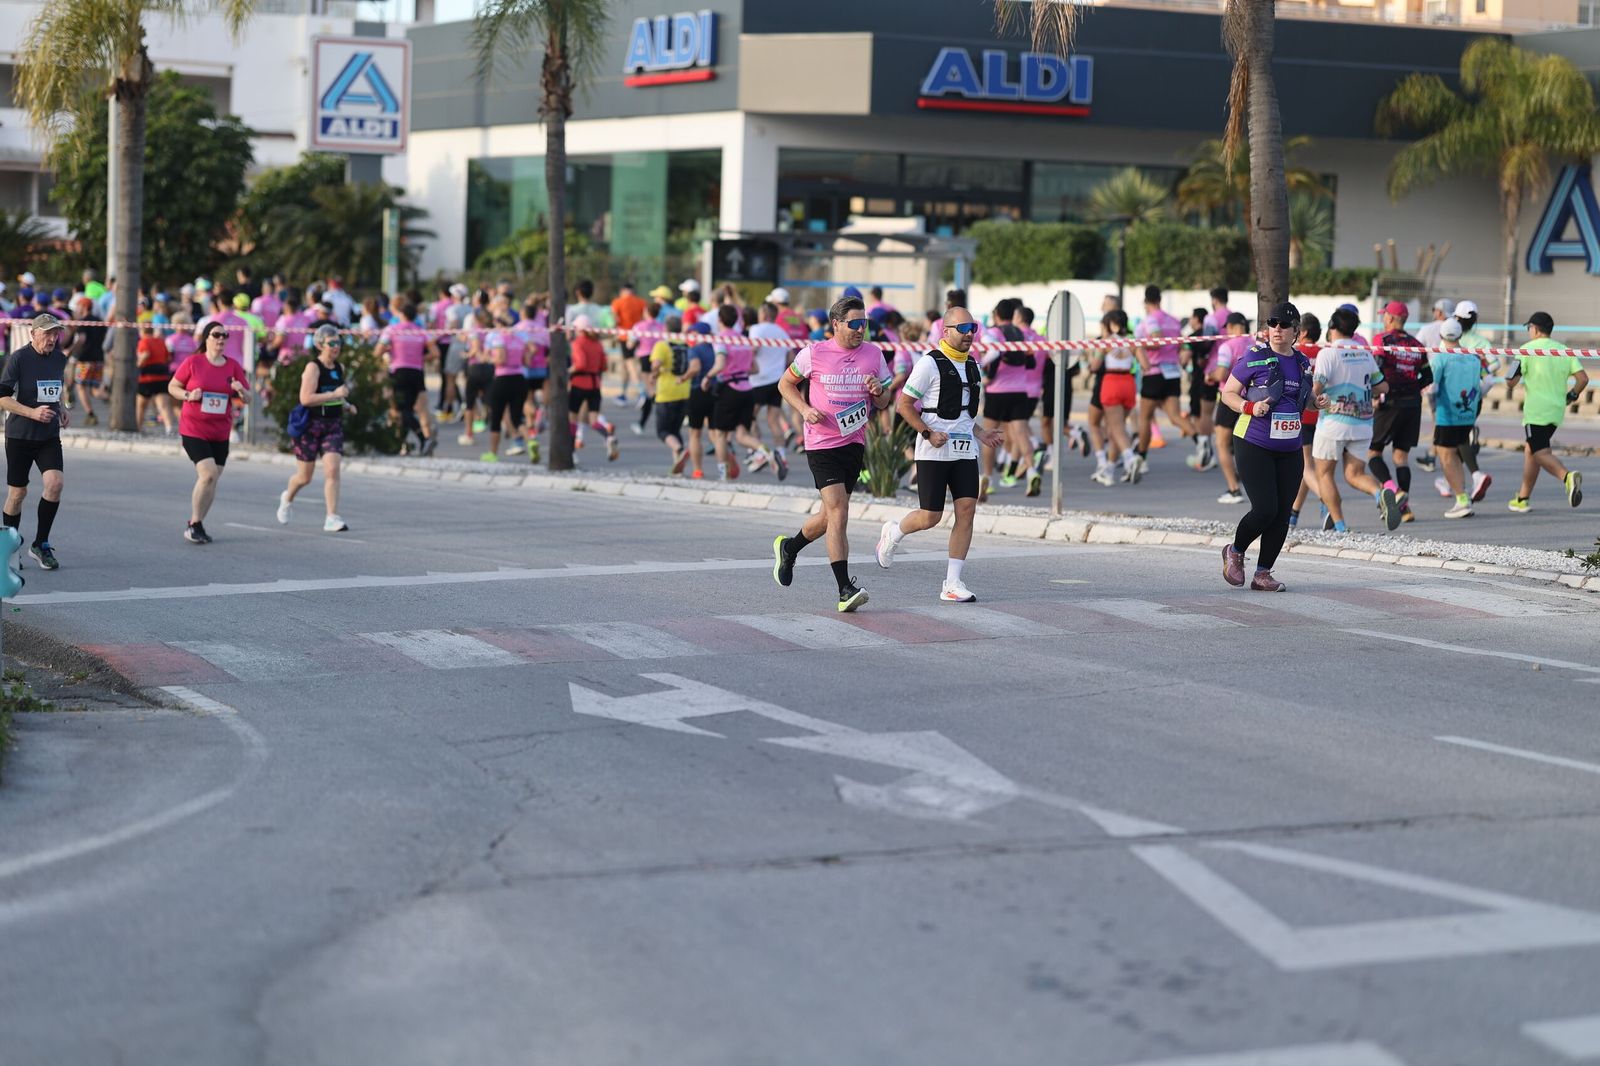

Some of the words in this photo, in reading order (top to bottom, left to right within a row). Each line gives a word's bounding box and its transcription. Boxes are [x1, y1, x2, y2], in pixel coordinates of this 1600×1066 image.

[623, 9, 713, 73] ALDI
[919, 46, 1094, 104] ALDI
[325, 117, 393, 137] ALDI
[820, 374, 844, 384] MEDIA
[845, 374, 866, 384] MARA
[43, 386, 60, 396] 167
[209, 397, 221, 408] 33
[840, 407, 867, 428] 1410
[1273, 420, 1301, 431] 1658
[952, 439, 971, 451] 177
